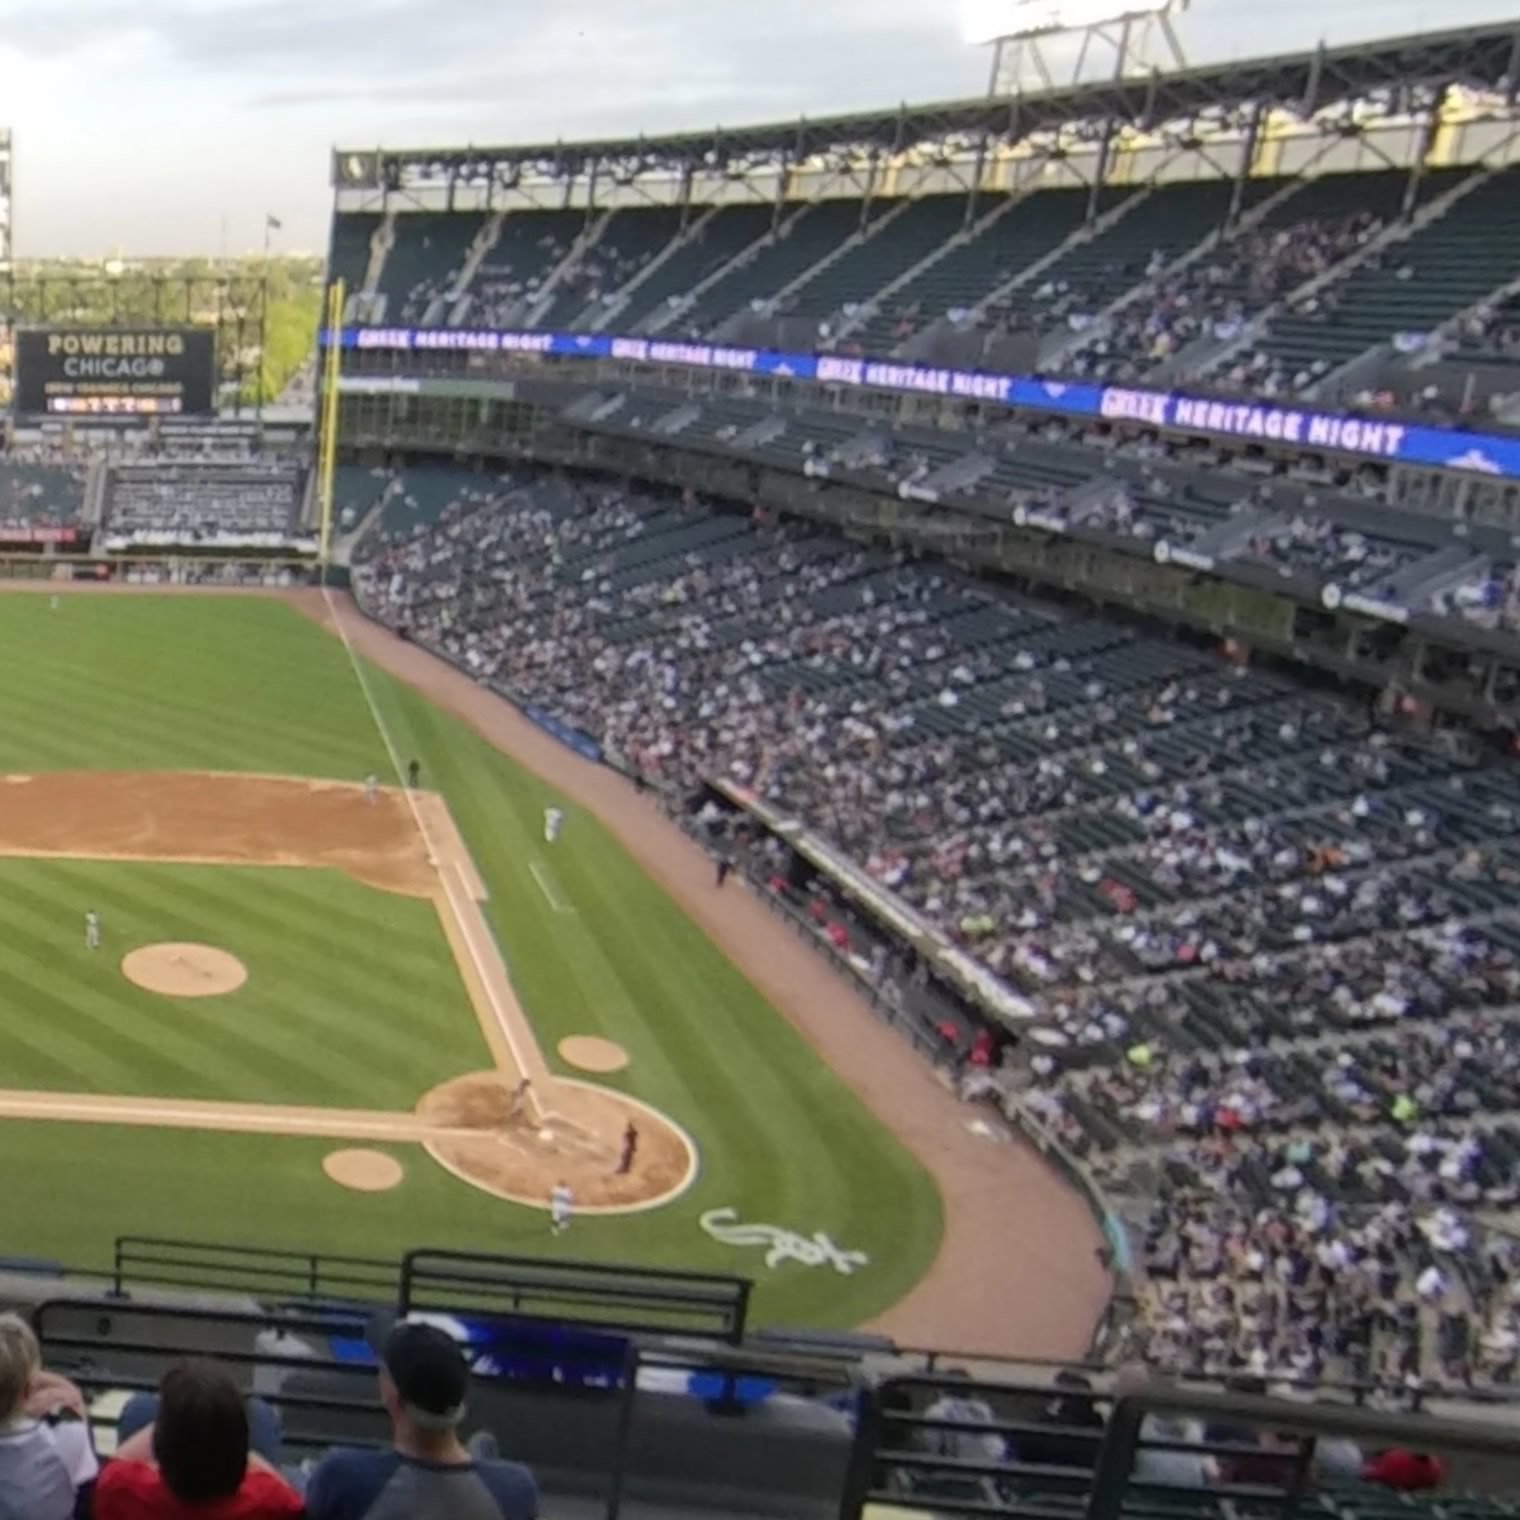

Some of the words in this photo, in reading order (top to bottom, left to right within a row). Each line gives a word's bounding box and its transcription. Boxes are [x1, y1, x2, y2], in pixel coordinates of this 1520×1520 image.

[48, 334, 184, 355] POWERING
[415, 331, 498, 350] HERITAGE
[501, 333, 553, 352] NIGHT
[650, 342, 711, 365] HERITAGE
[713, 348, 758, 369] NIGHT
[866, 362, 950, 393] HERITAGE
[952, 371, 1013, 400] NIGHT
[1101, 387, 1170, 424] GREEK
[1174, 398, 1303, 440] HERITAGE
[1308, 418, 1405, 455] NIGHT
